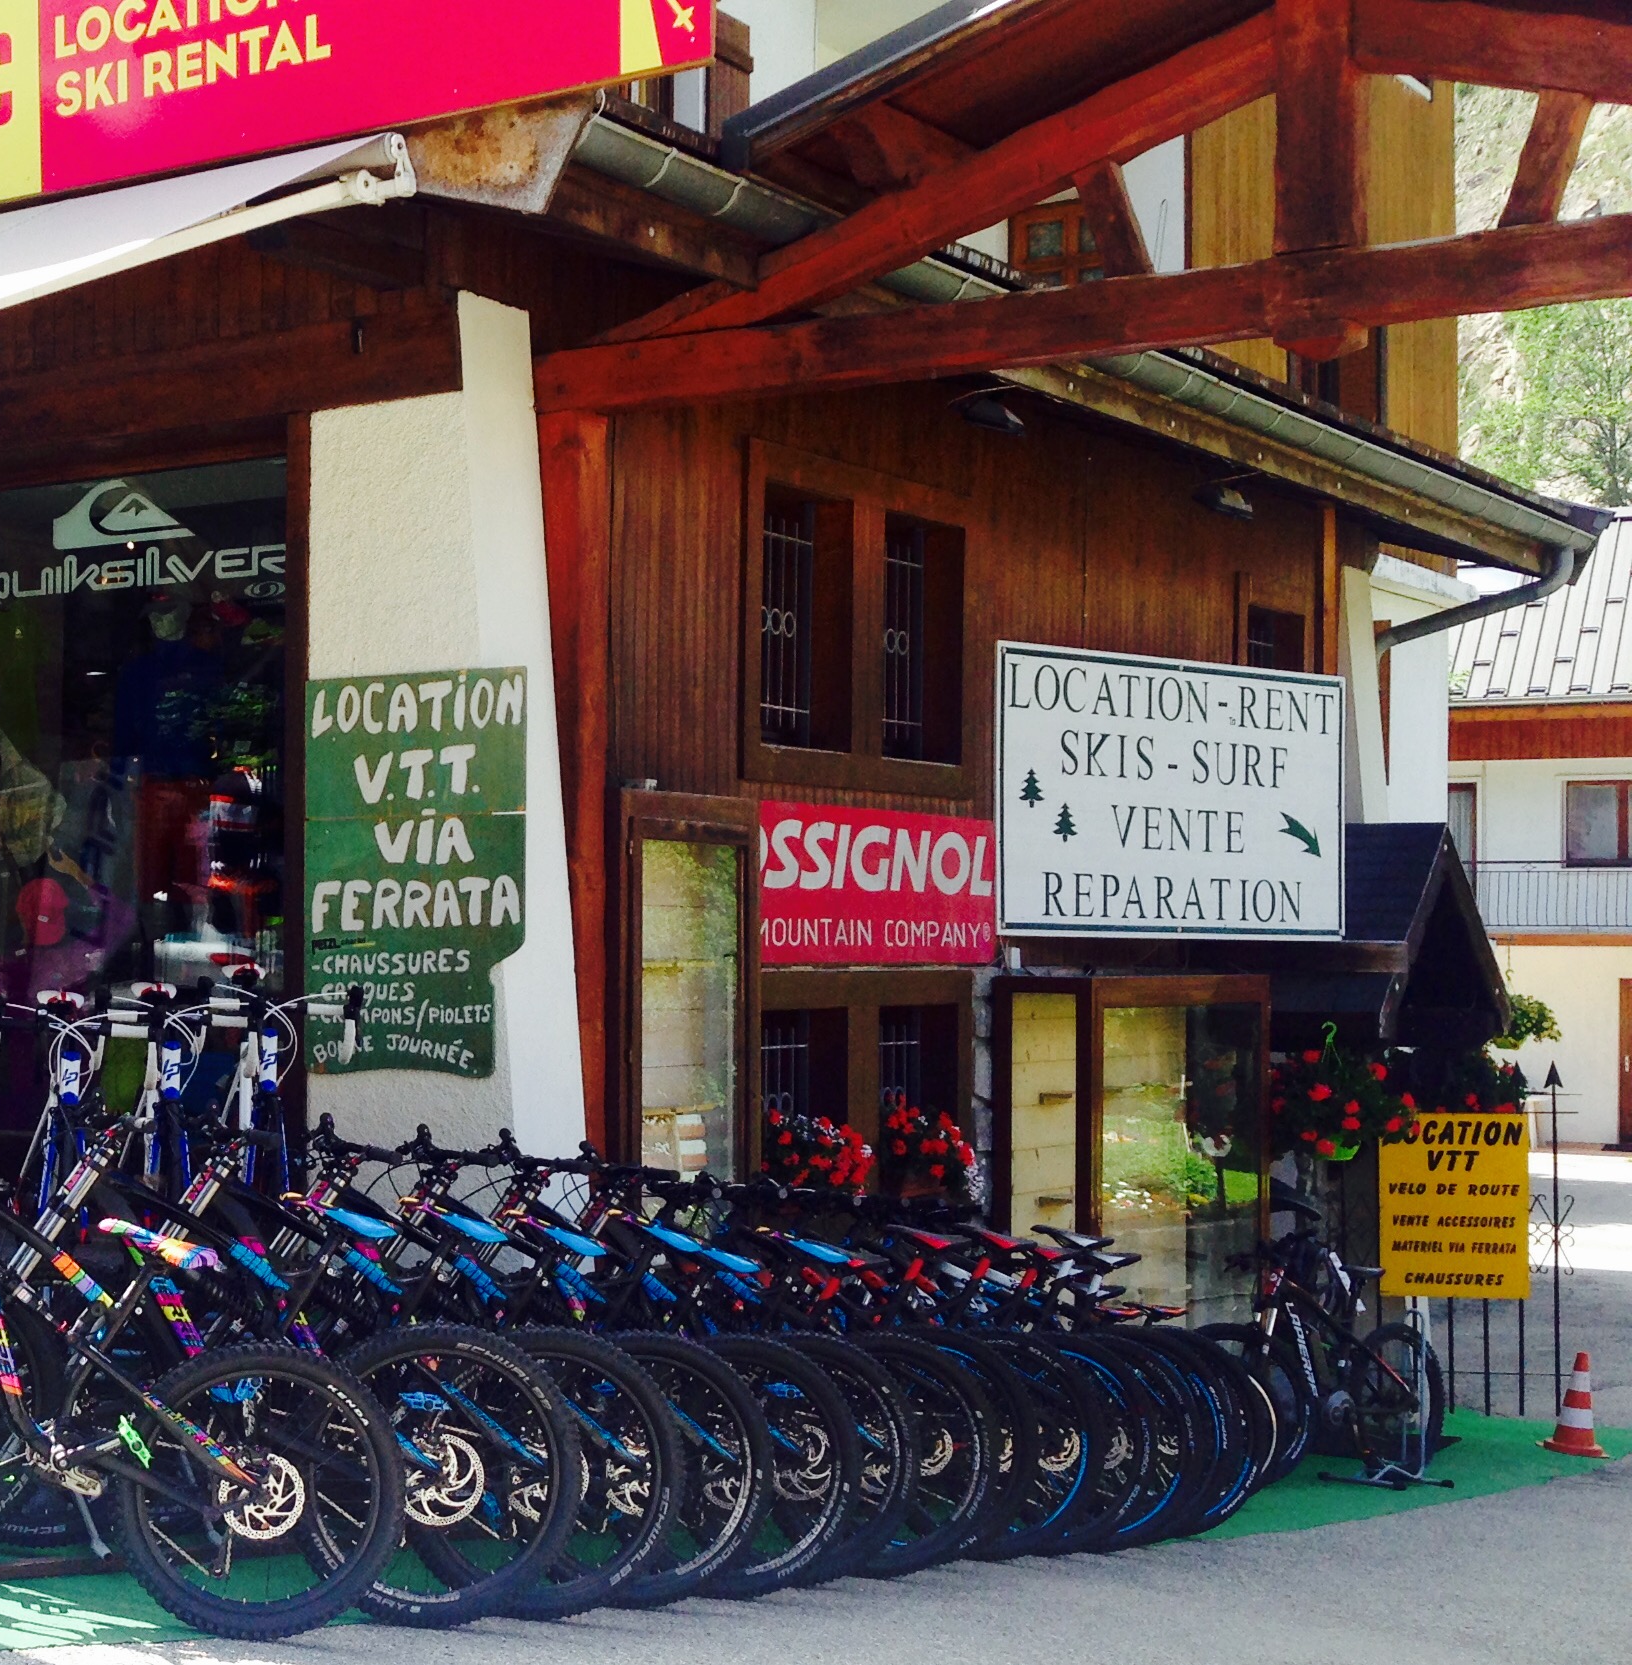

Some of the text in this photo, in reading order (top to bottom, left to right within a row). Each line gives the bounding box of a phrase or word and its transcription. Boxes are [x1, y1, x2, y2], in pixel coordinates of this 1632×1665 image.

[55, 0, 299, 58] LOCATI
[55, 14, 332, 117] SKI RENTAL
[311, 674, 524, 739] LOCATION
[1007, 662, 1209, 723] LOCATION
[1237, 685, 1335, 735] RENT
[353, 743, 481, 804] V.T.T.
[1060, 729, 1154, 781] SKIS
[1192, 739, 1288, 788] SURF
[374, 808, 475, 866] VIA
[1111, 804, 1245, 854] VENTE
[760, 818, 994, 897] SSIGNOL
[311, 874, 521, 934] FERRATA
[1041, 871, 1302, 923] REPARATION
[386, 1034, 475, 1070] JOURNÉE
[1382, 1120, 1523, 1147] CATION
[1427, 1150, 1480, 1172] VTT
[1389, 1183, 1520, 1197] VELO DE ROUTE
[1391, 1240, 1517, 1255] MATERIEL VIA FERRATA
[1392, 1215, 1516, 1229] VENTE ACCESSOIRES
[1404, 1272, 1504, 1286] CHAUSSURES
[1284, 1301, 1319, 1398] LAPIERRE
[327, 1384, 370, 1426] KENDA
[700, 1534, 742, 1578] MAGIC
[777, 1543, 822, 1579] MAGIC
